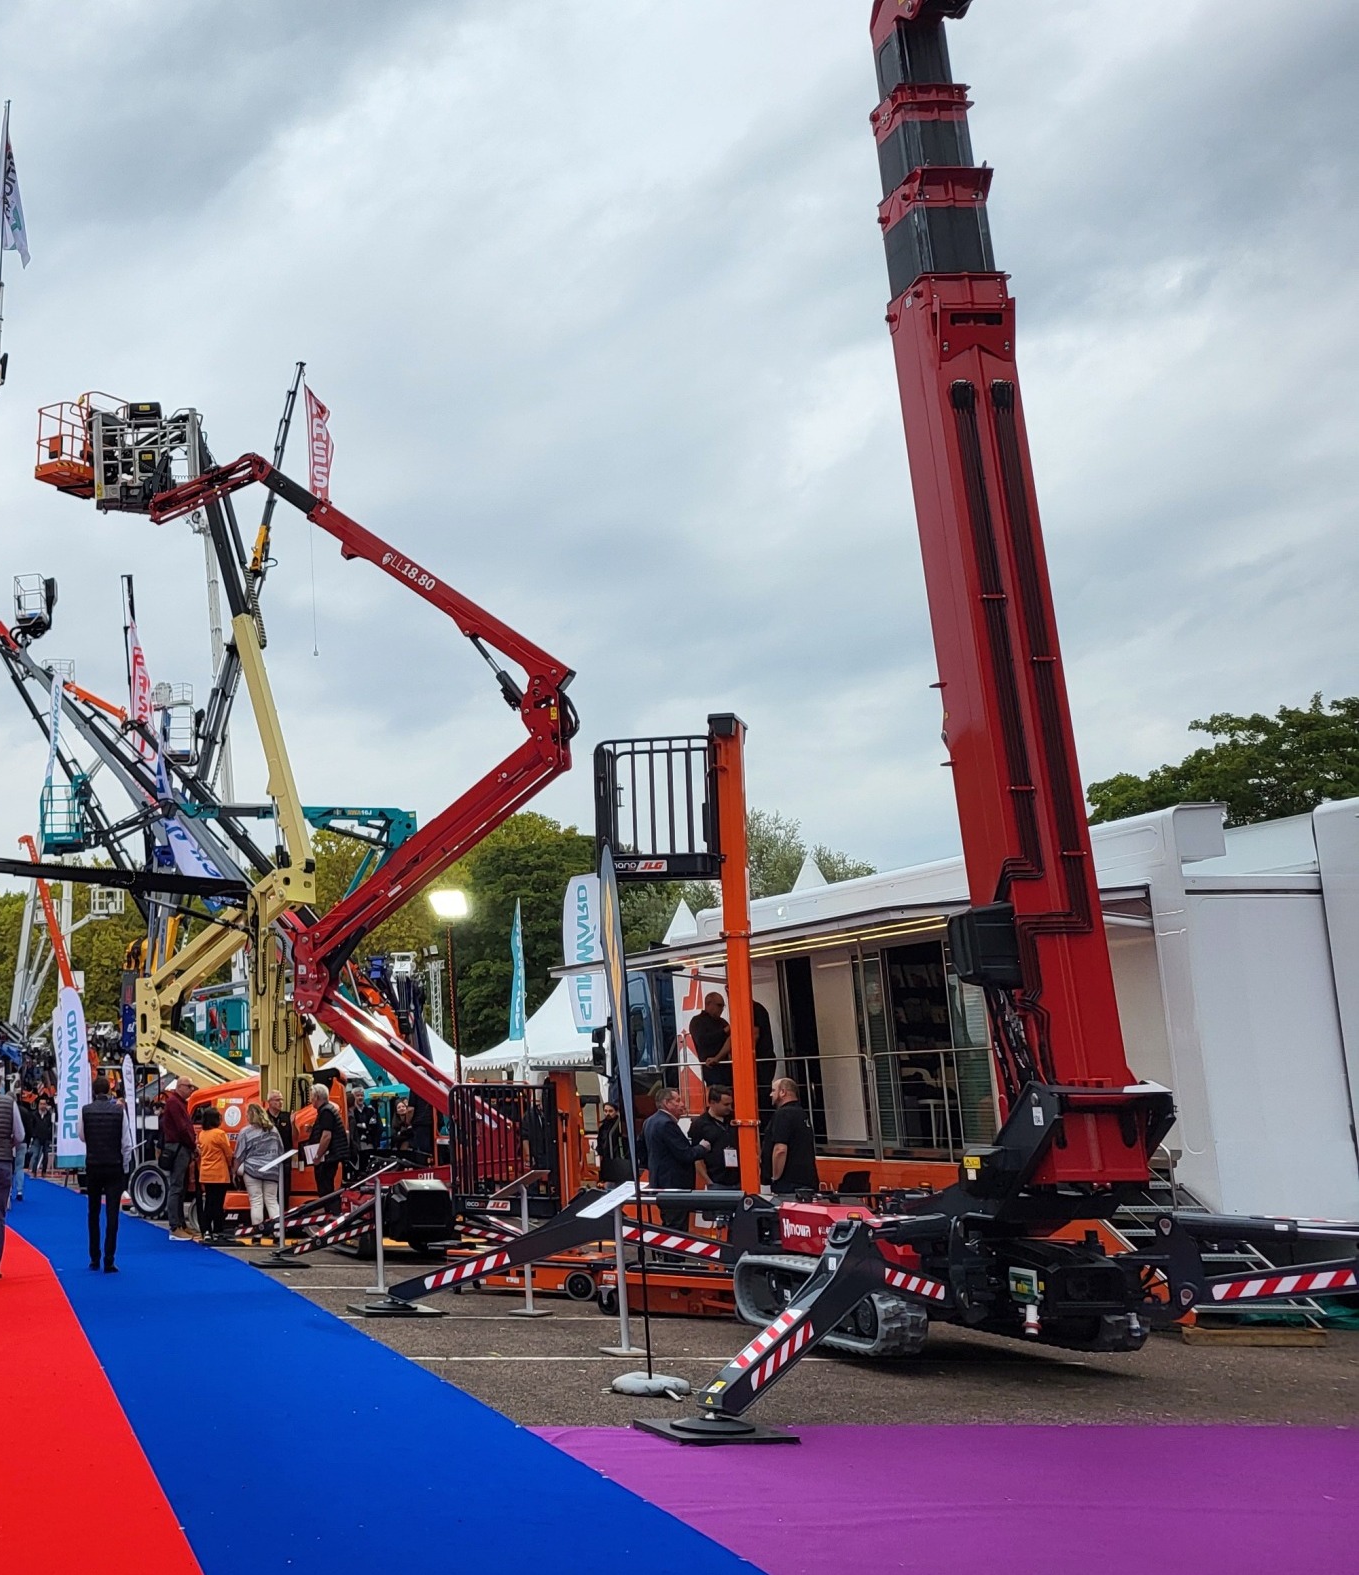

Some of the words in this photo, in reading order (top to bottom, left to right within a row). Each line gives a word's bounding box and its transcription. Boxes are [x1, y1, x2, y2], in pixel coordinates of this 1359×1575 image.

[640, 862, 664, 870] JLG
[489, 1201, 509, 1209] JLG
[782, 1217, 812, 1239] Hinowa
